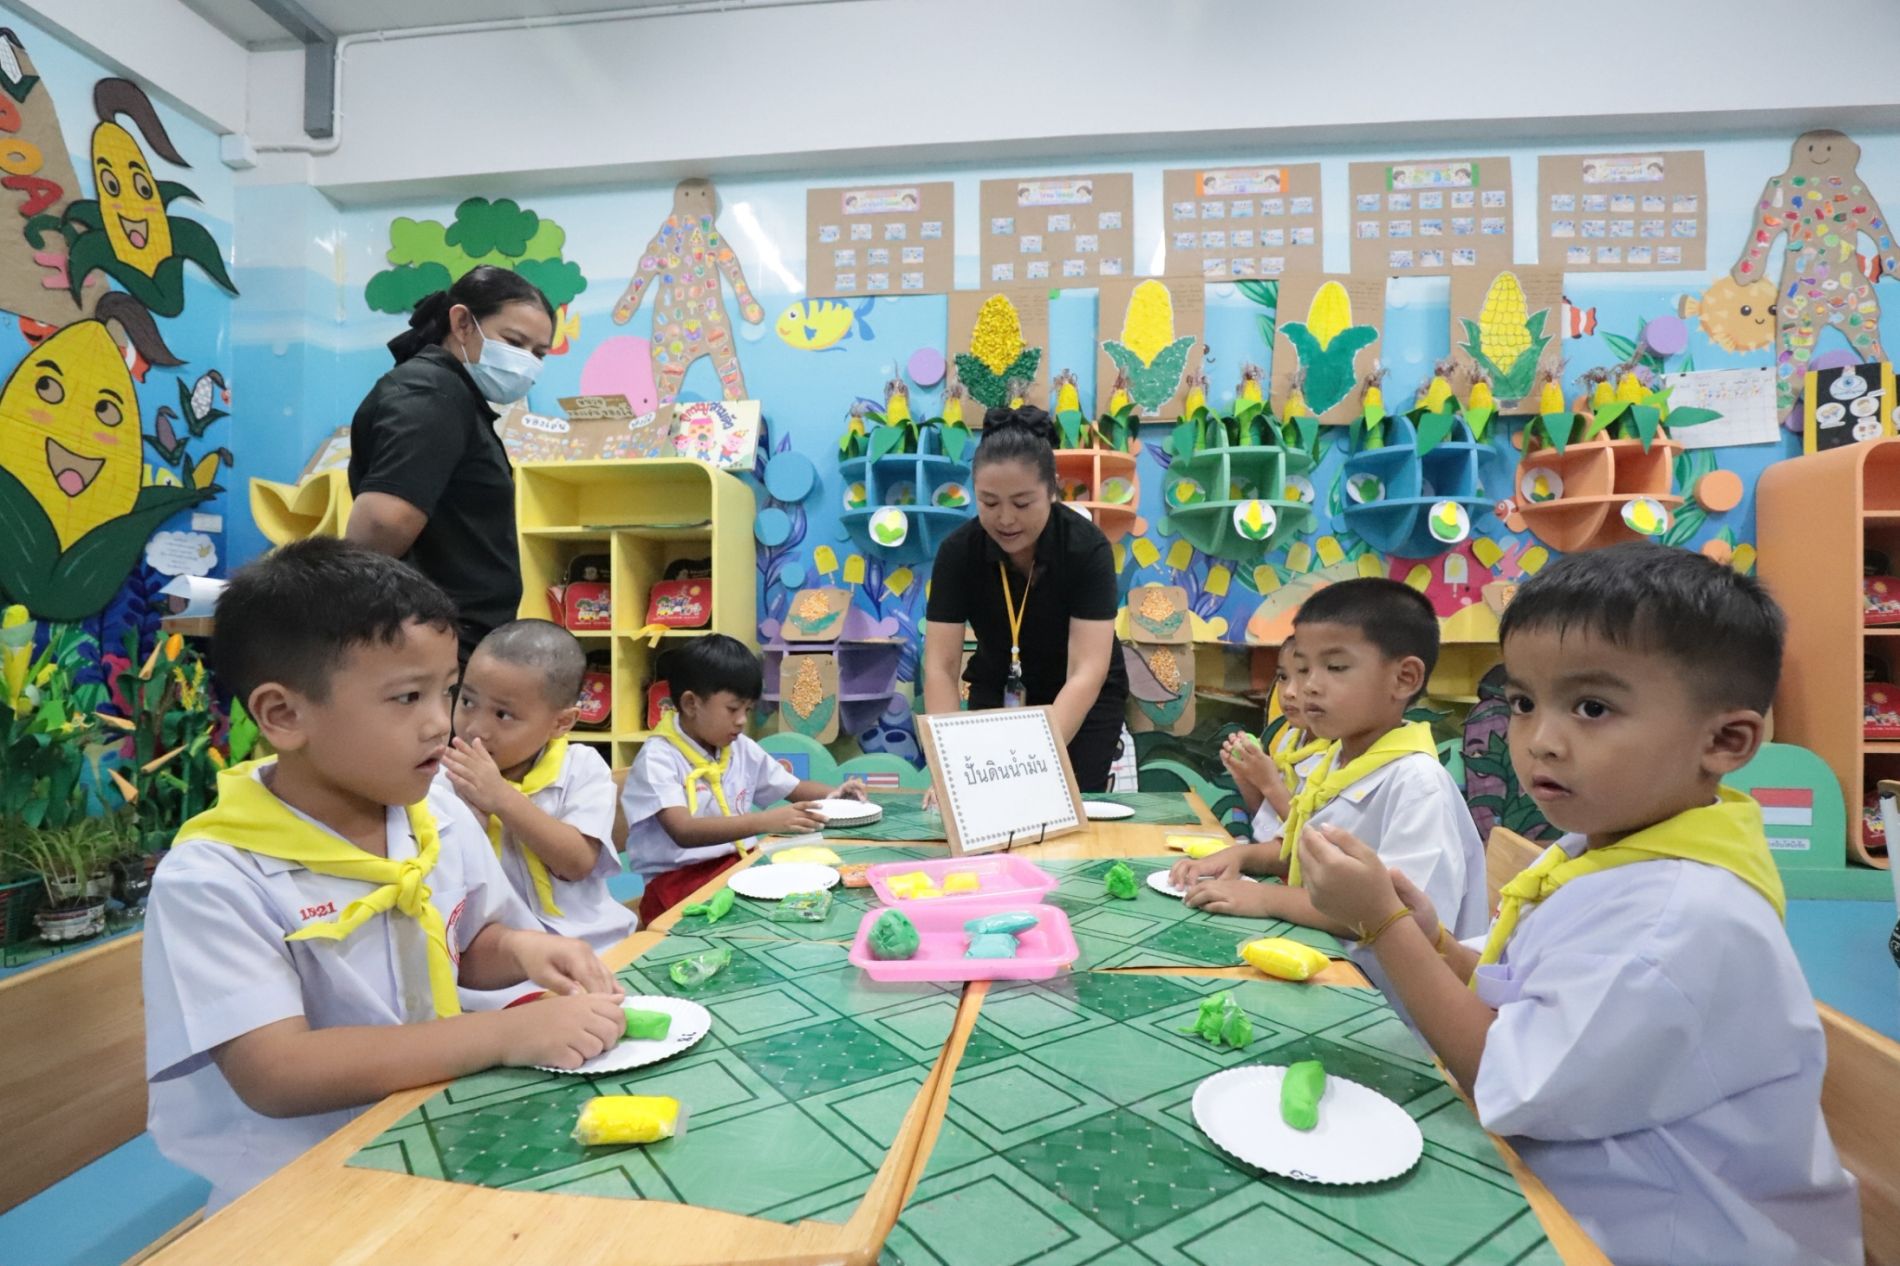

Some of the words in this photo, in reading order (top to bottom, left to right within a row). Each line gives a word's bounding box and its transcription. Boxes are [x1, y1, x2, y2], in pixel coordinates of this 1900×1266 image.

[963, 748, 1048, 785] ปั้นดินน้ำมัน
[299, 901, 337, 921] 1521
